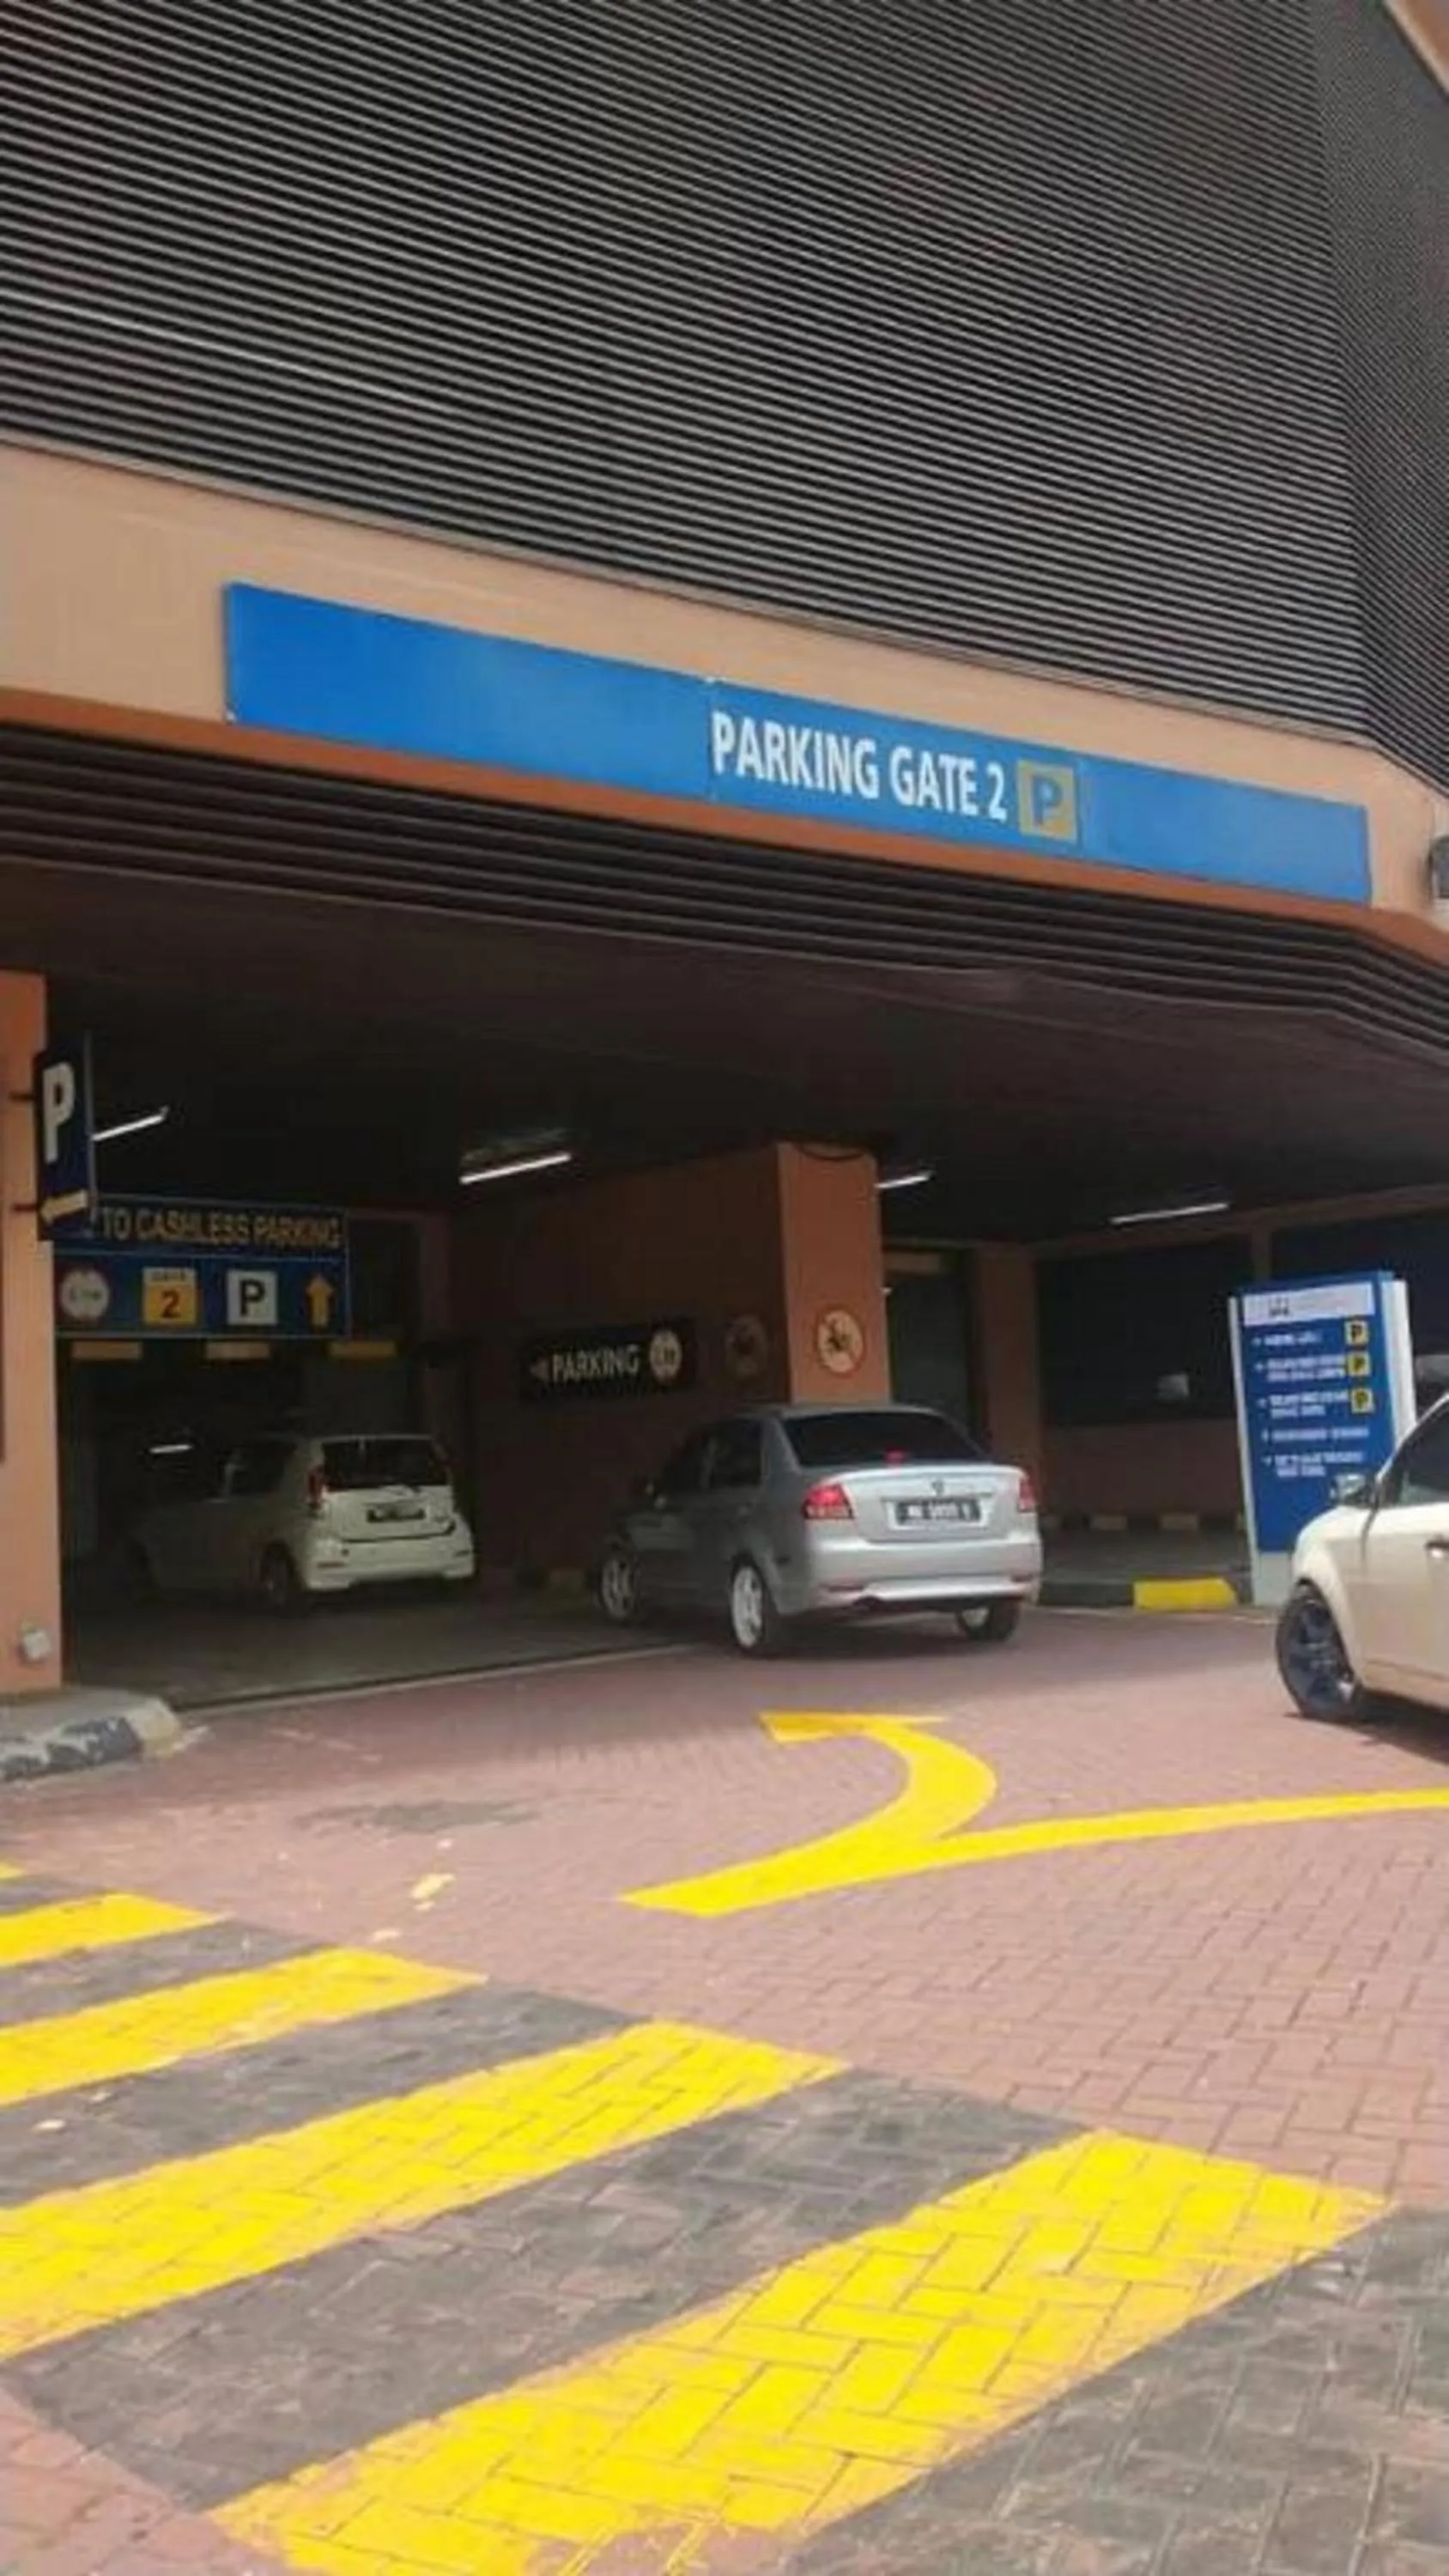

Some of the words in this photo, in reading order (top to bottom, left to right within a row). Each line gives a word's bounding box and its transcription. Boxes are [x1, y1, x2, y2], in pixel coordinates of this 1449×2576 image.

[712, 710, 879, 799] PARKING
[890, 746, 979, 817] GATE
[988, 763, 1008, 823] 2
[1033, 773, 1064, 829] P
[42, 1061, 76, 1163] P
[100, 1206, 131, 1242] TO
[136, 1208, 250, 1246] CASHLESS
[253, 1213, 341, 1249] PARKING
[161, 1289, 181, 1319] 2
[239, 1279, 266, 1318] P
[552, 1345, 641, 1382] PARKING
